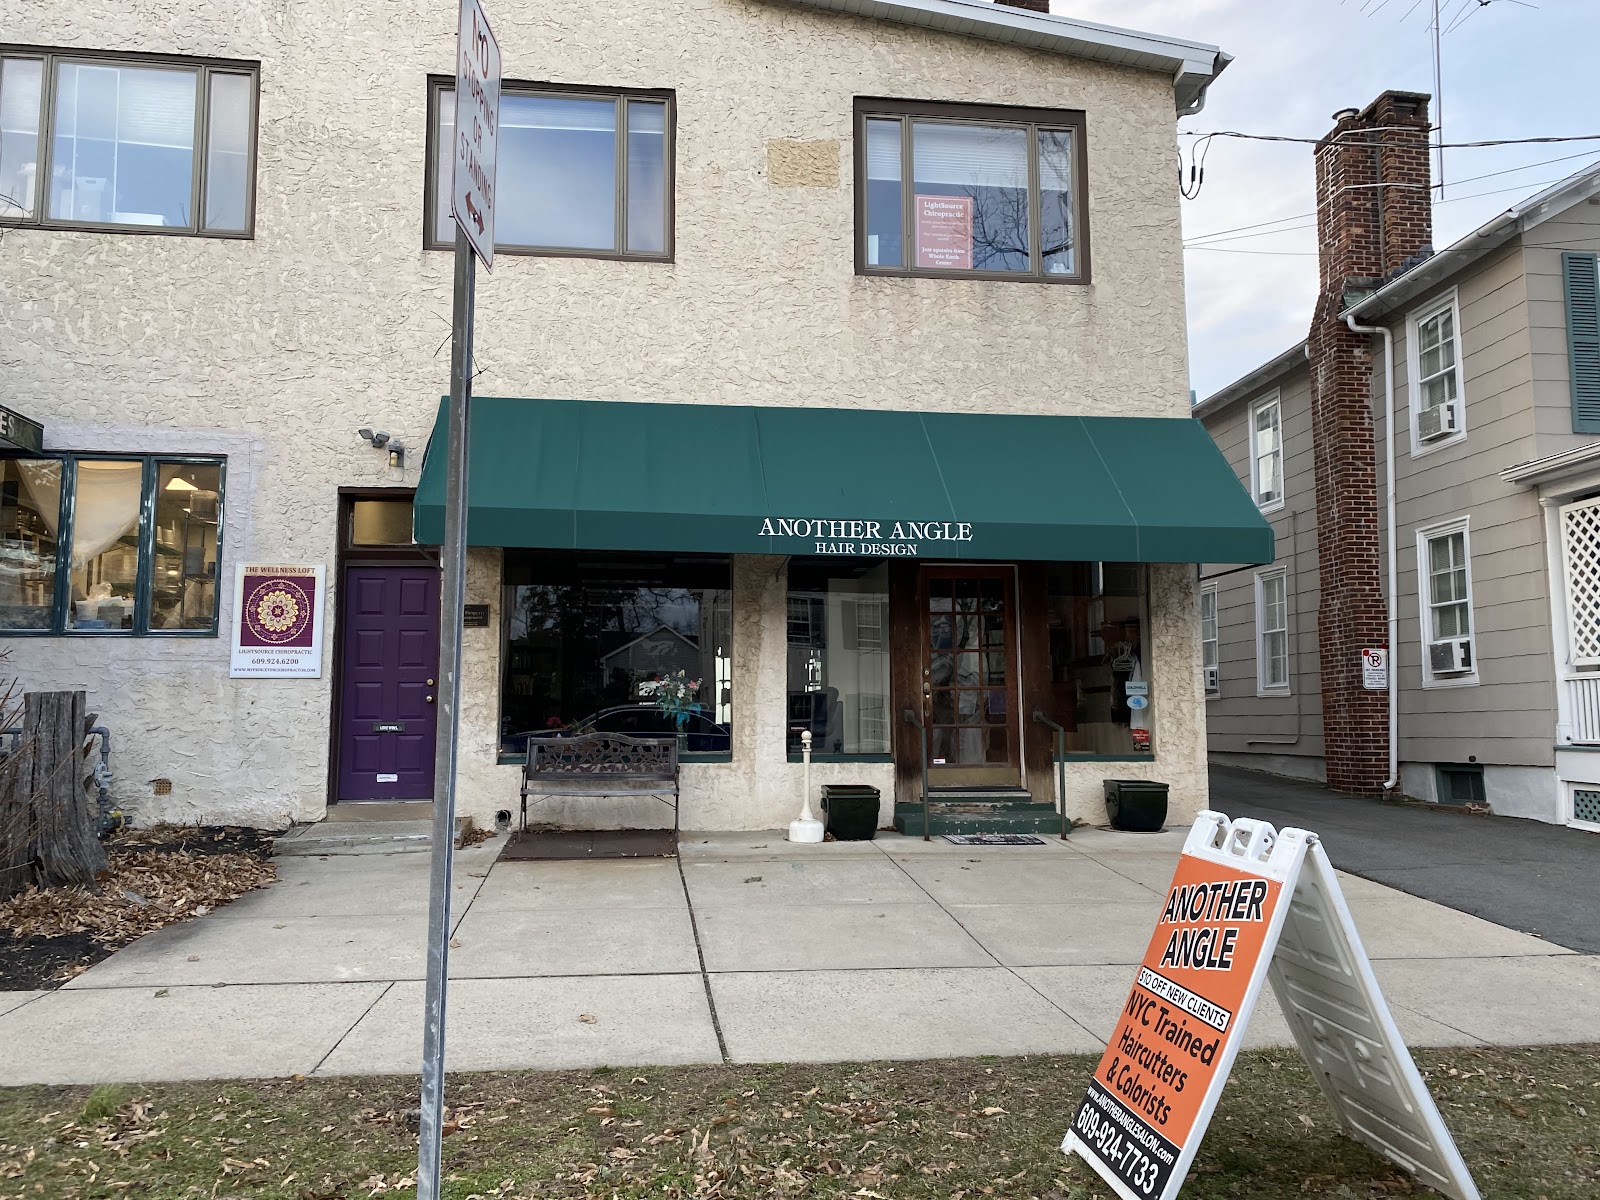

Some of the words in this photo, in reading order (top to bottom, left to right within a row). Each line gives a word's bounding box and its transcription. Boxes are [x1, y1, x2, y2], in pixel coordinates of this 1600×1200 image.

[472, 9, 488, 79] NO
[463, 51, 494, 136] STOPPING
[473, 116, 482, 153] OR
[460, 131, 492, 210] STANDING
[923, 209, 964, 218] Chiropractic
[924, 201, 964, 210] LightSource
[757, 517, 883, 540] ANOTHER
[889, 521, 974, 542] ANGLE
[815, 542, 856, 555] HAIR
[860, 543, 918, 556] DESIGN
[244, 566, 259, 574] THE
[1160, 879, 1268, 925] ANOTHER
[1159, 927, 1239, 971] ANGLE
[1139, 970, 1152, 986] $10
[1151, 977, 1168, 994] OFF
[1166, 985, 1188, 1006] NEW
[1187, 997, 1226, 1027] CLIENTS
[1125, 989, 1157, 1026] NYC
[1153, 1006, 1220, 1067] Trained
[1117, 1024, 1188, 1093] Haircutters
[1105, 1056, 1120, 1084] &
[1116, 1064, 1172, 1126] Colorists
[1077, 1102, 1159, 1195] 609-924-7733
[1087, 1085, 1175, 1166] www.ANOTHERANGLESALON.com
